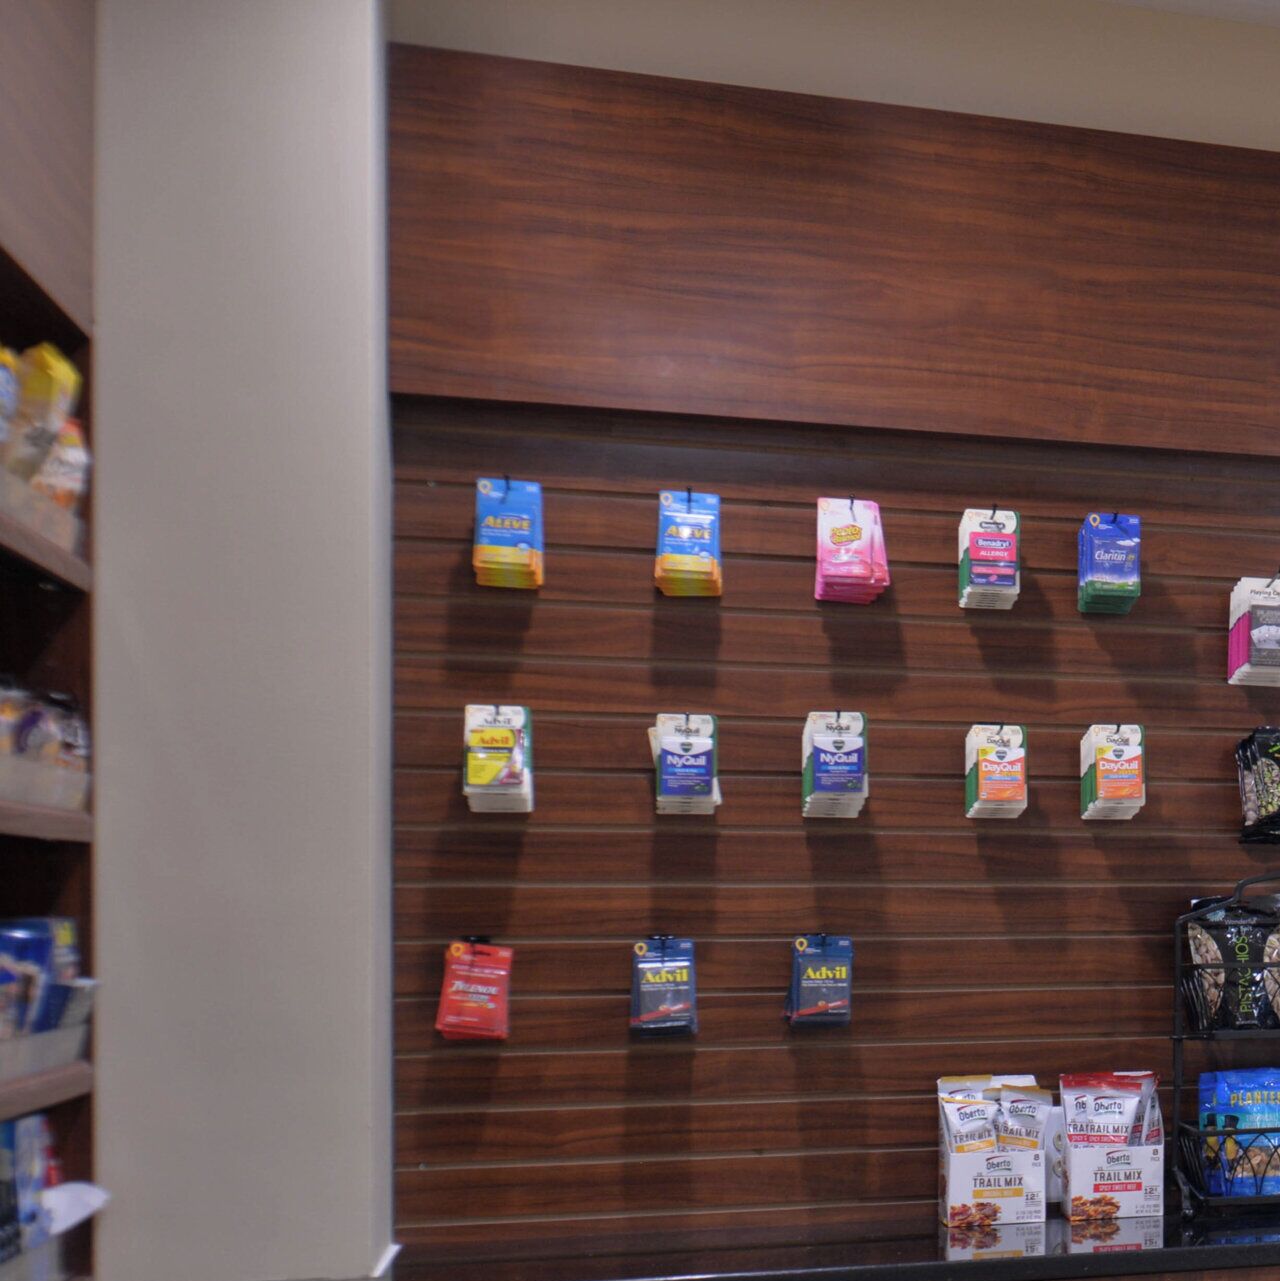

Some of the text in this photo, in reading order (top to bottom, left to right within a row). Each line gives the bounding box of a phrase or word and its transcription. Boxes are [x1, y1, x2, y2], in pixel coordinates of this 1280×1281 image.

[481, 515, 531, 530] ALEVE
[977, 539, 1011, 549] Benadryl
[980, 550, 1008, 558] ALLERGY
[1095, 550, 1126, 562] Claritin
[1250, 589, 1272, 598] Playing
[480, 735, 510, 746] Advil
[666, 755, 707, 768] NyQuil
[820, 753, 858, 766] NyQuil
[982, 762, 1022, 774] DayQuil
[1099, 761, 1139, 772] DayQuil
[641, 969, 689, 983] Advil
[802, 966, 849, 979] Advil
[1009, 1103, 1037, 1114] Oberto
[1094, 1101, 1122, 1112] Oberto
[959, 1108, 986, 1120] Oberto
[979, 1128, 993, 1138] MIX
[1025, 1128, 1040, 1139] MIX
[1112, 1124, 1130, 1134] MIX
[1033, 1153, 1040, 1161] 8
[1106, 1154, 1130, 1165] Oberto
[986, 1159, 1011, 1171] Oberto
[1094, 1170, 1142, 1182] TRAIL MIX
[973, 1176, 1024, 1188] TRAIL MIX
